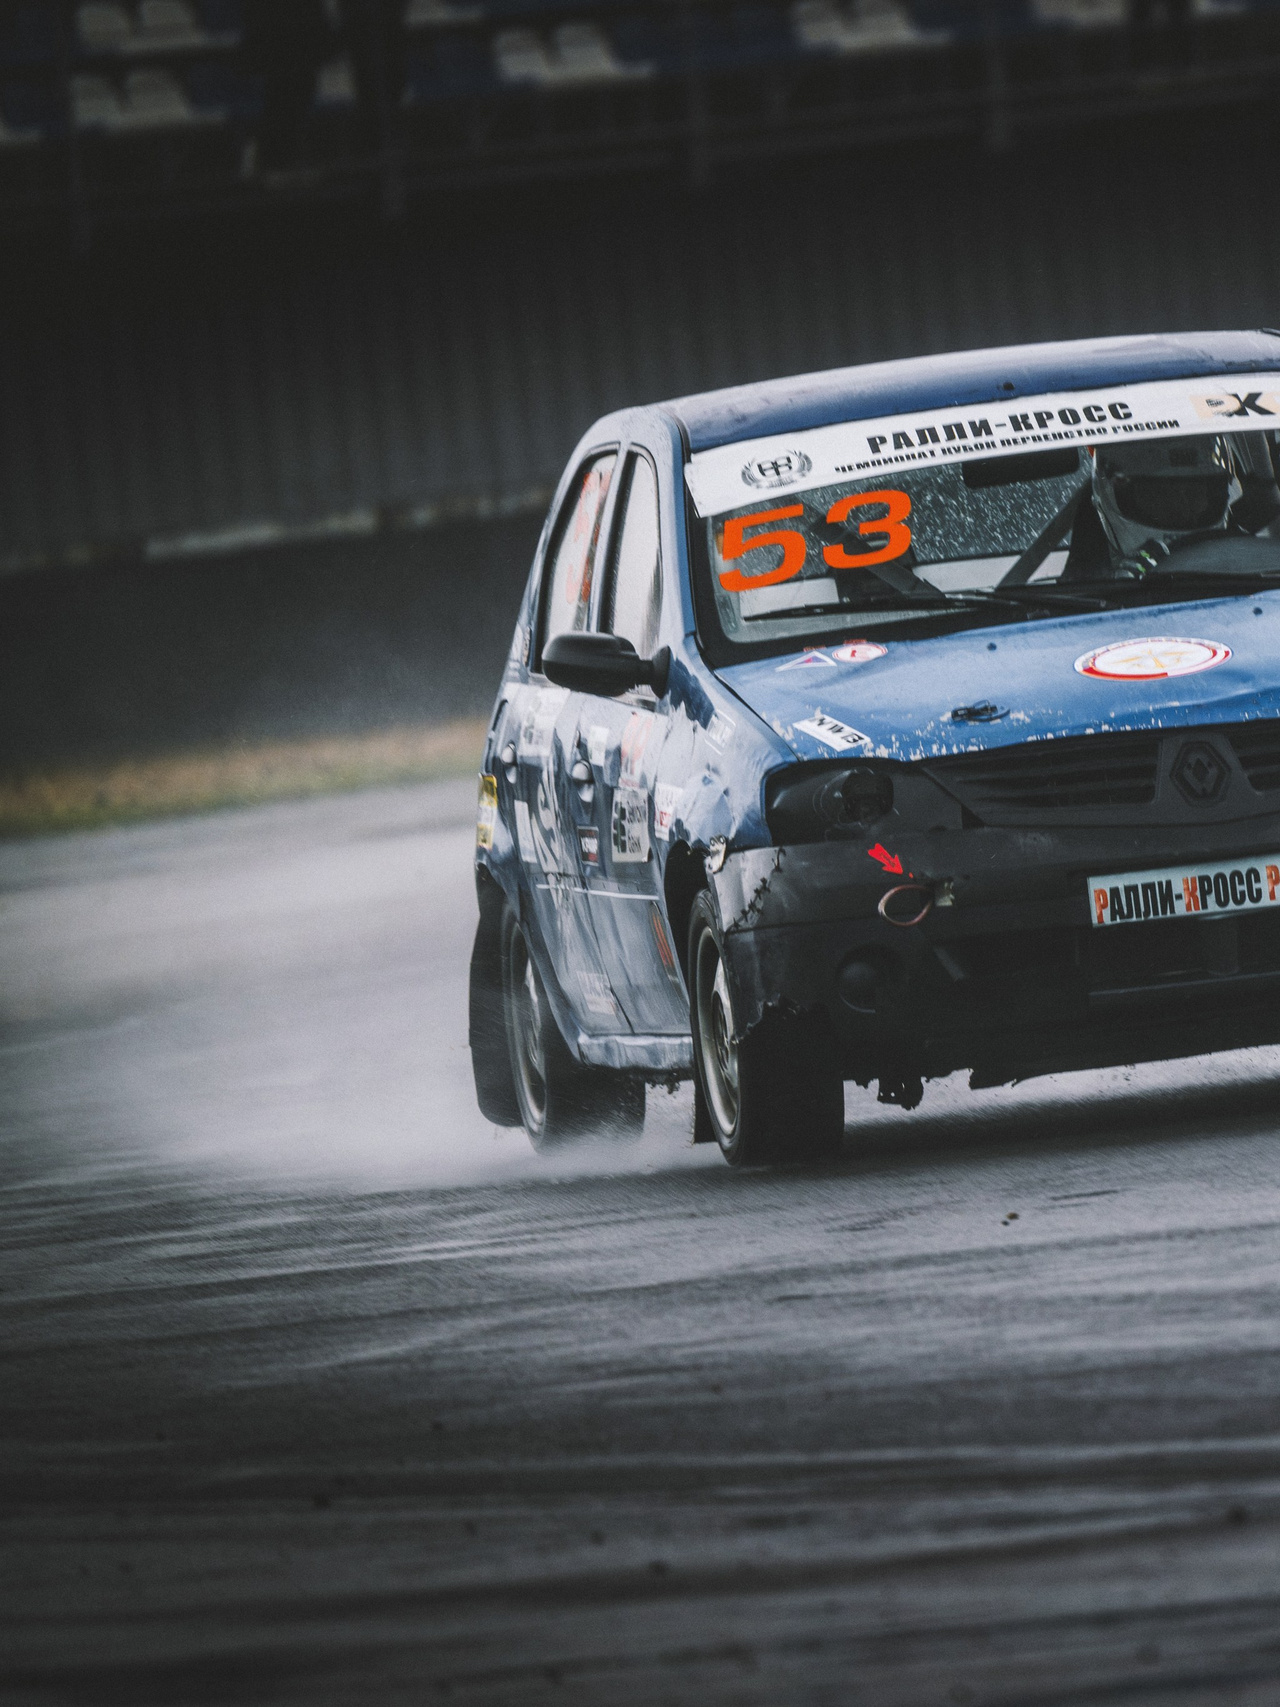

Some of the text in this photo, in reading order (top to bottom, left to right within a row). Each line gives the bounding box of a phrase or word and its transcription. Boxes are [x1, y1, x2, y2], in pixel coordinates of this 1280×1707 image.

[834, 450, 937, 473] ЧЕМПИОНАТ
[1111, 419, 1181, 435] РОССИИ
[866, 402, 1133, 454] РАЛЛИ-КРОСС
[718, 489, 912, 592] 53
[1093, 867, 1263, 924] РАЛЛИ-КРОСС
